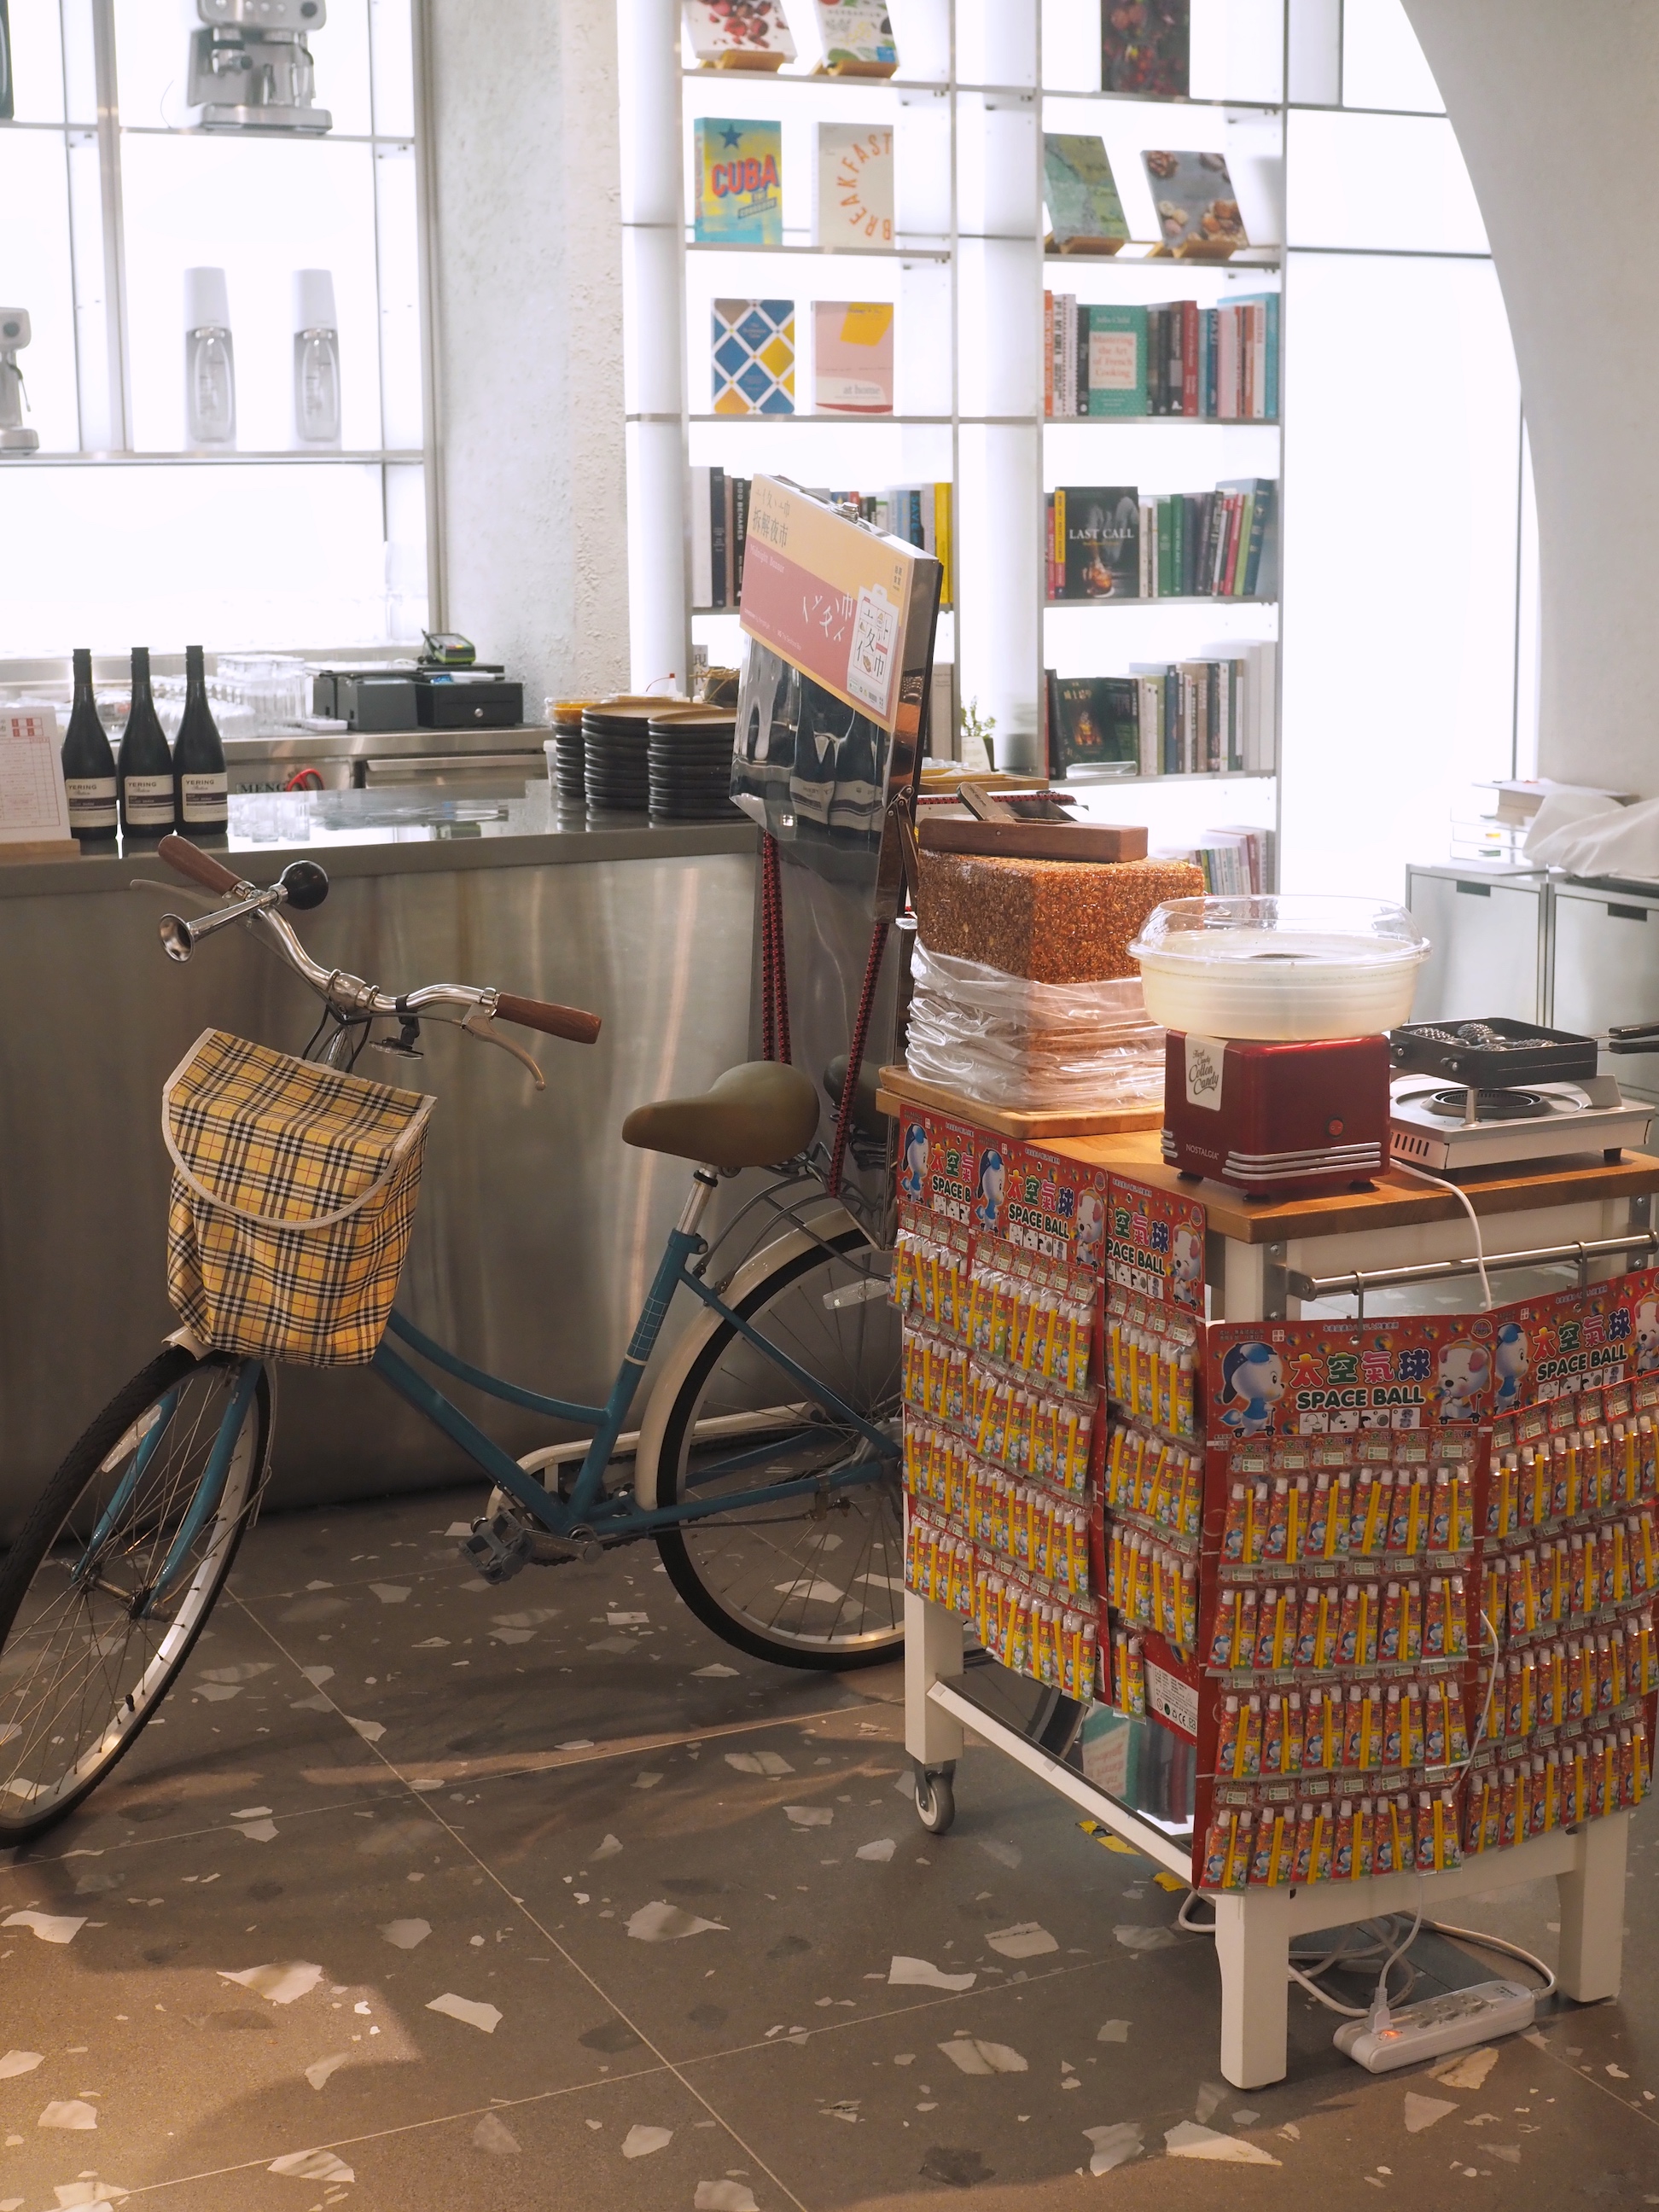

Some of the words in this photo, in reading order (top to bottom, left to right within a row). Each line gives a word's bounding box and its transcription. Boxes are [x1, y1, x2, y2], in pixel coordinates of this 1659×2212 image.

[712, 154, 779, 198] CUBA
[836, 132, 893, 241] BREAKFAST
[1068, 528, 1099, 539] LAST
[1102, 527, 1135, 538] CALL
[1189, 1064, 1214, 1083] Cotton
[1193, 1074, 1220, 1096] Candy
[930, 1143, 974, 1183] 太空氣
[932, 1174, 963, 1201] SPACE
[1007, 1169, 1074, 1219] 太空氣球
[1008, 1202, 1043, 1230] SPACE
[1044, 1214, 1070, 1241] BALL
[1107, 1237, 1135, 1265] PACE
[1137, 1249, 1167, 1278] BALL
[1532, 1307, 1632, 1363] 太空氣球
[1289, 1348, 1431, 1388] 太空氣球
[1537, 1351, 1588, 1382] SPACE
[1589, 1342, 1628, 1371] BALL
[1295, 1387, 1367, 1411] SPACE
[1372, 1384, 1425, 1407] BALL
